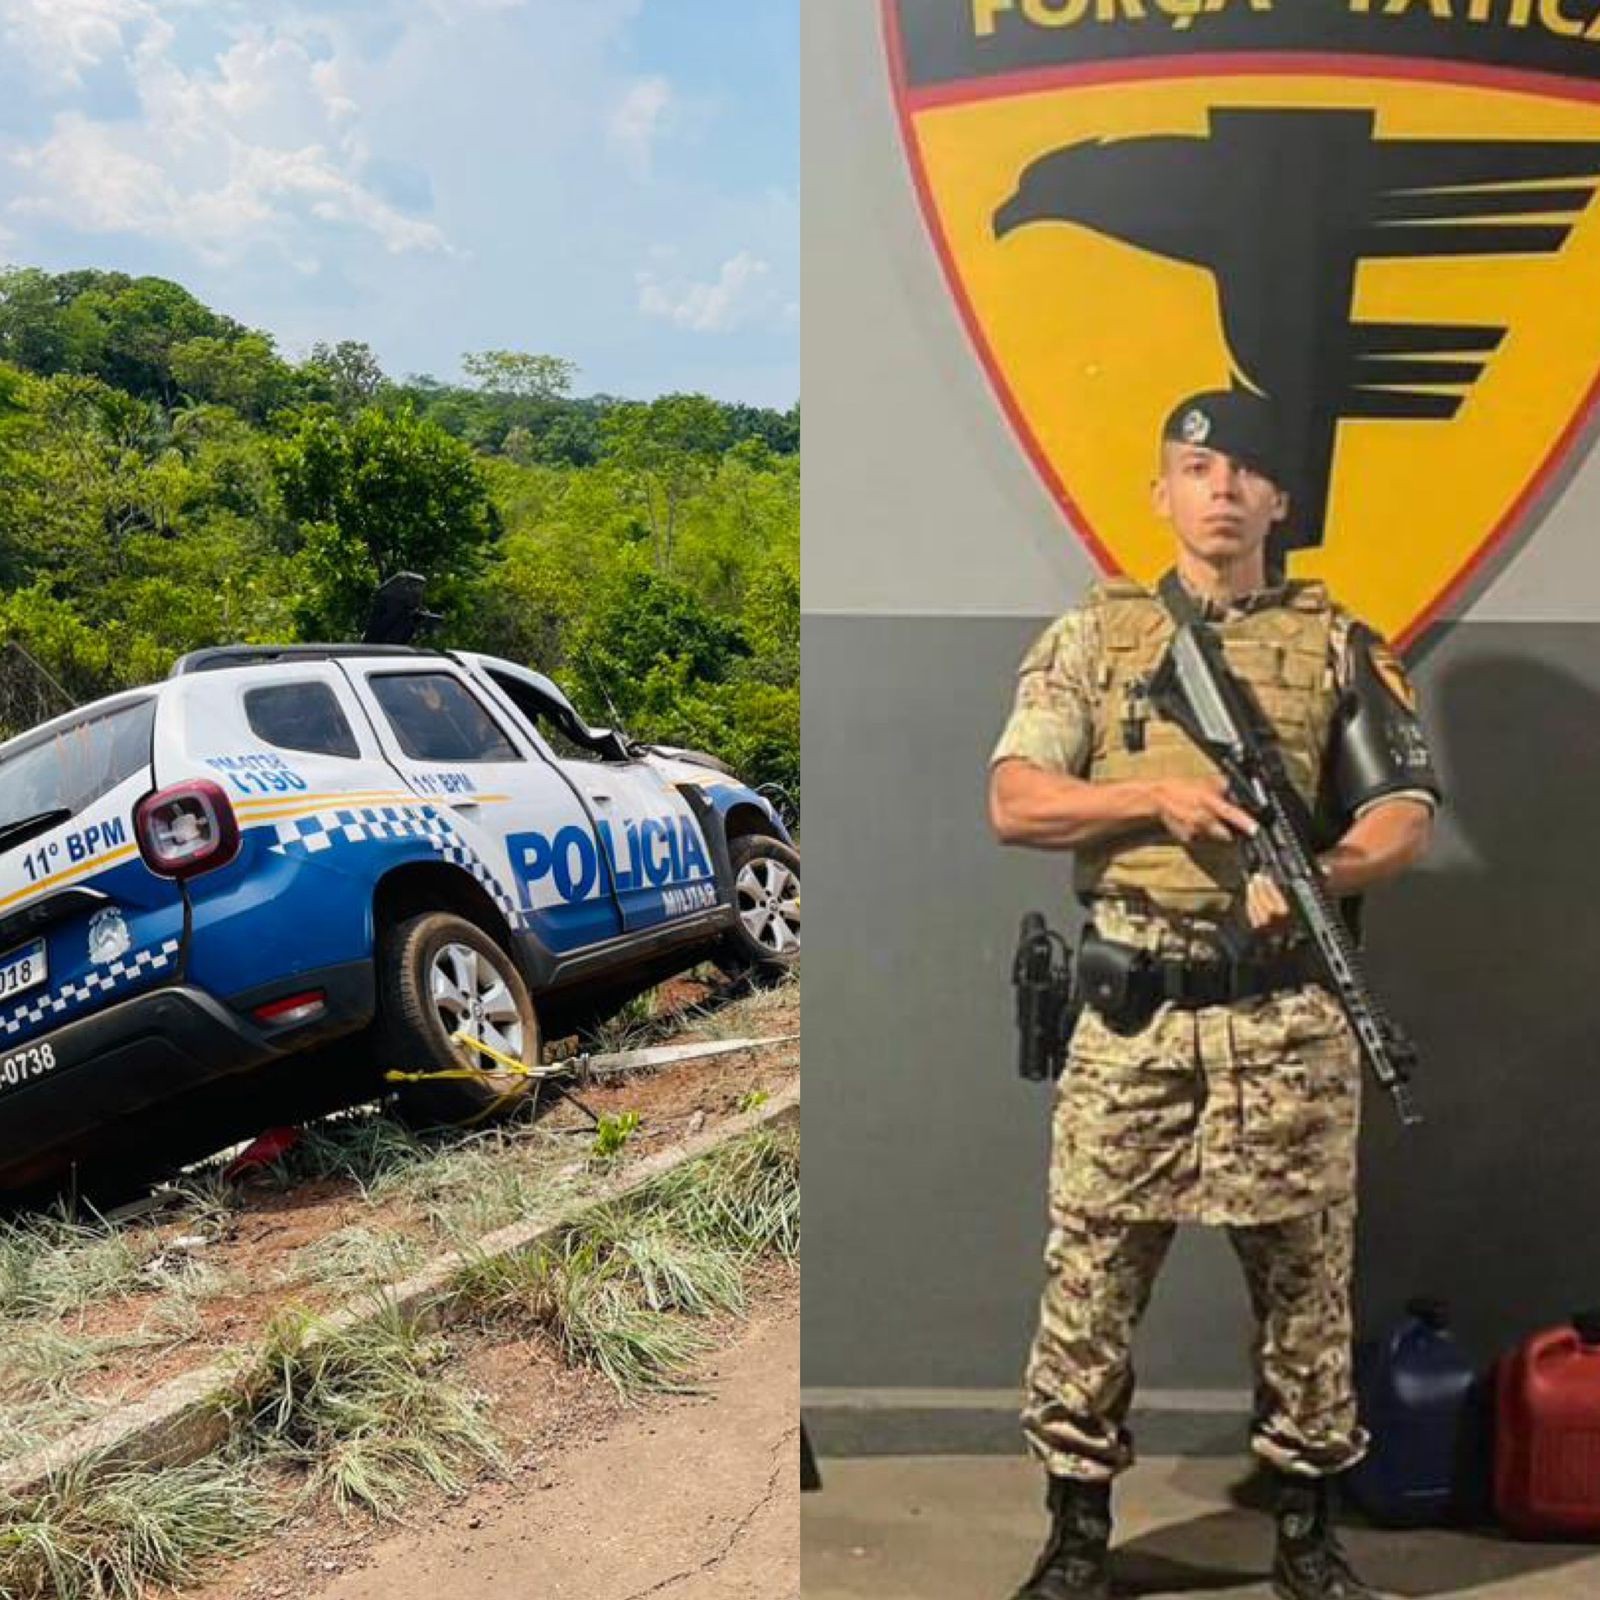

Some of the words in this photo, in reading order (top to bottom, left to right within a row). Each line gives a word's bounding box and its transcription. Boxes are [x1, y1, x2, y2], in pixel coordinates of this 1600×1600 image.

[66, 816, 125, 862] BPM
[506, 815, 712, 909] POLÍCIA
[662, 882, 717, 916] MILITAR
[0, 1043, 56, 1088] -0738
